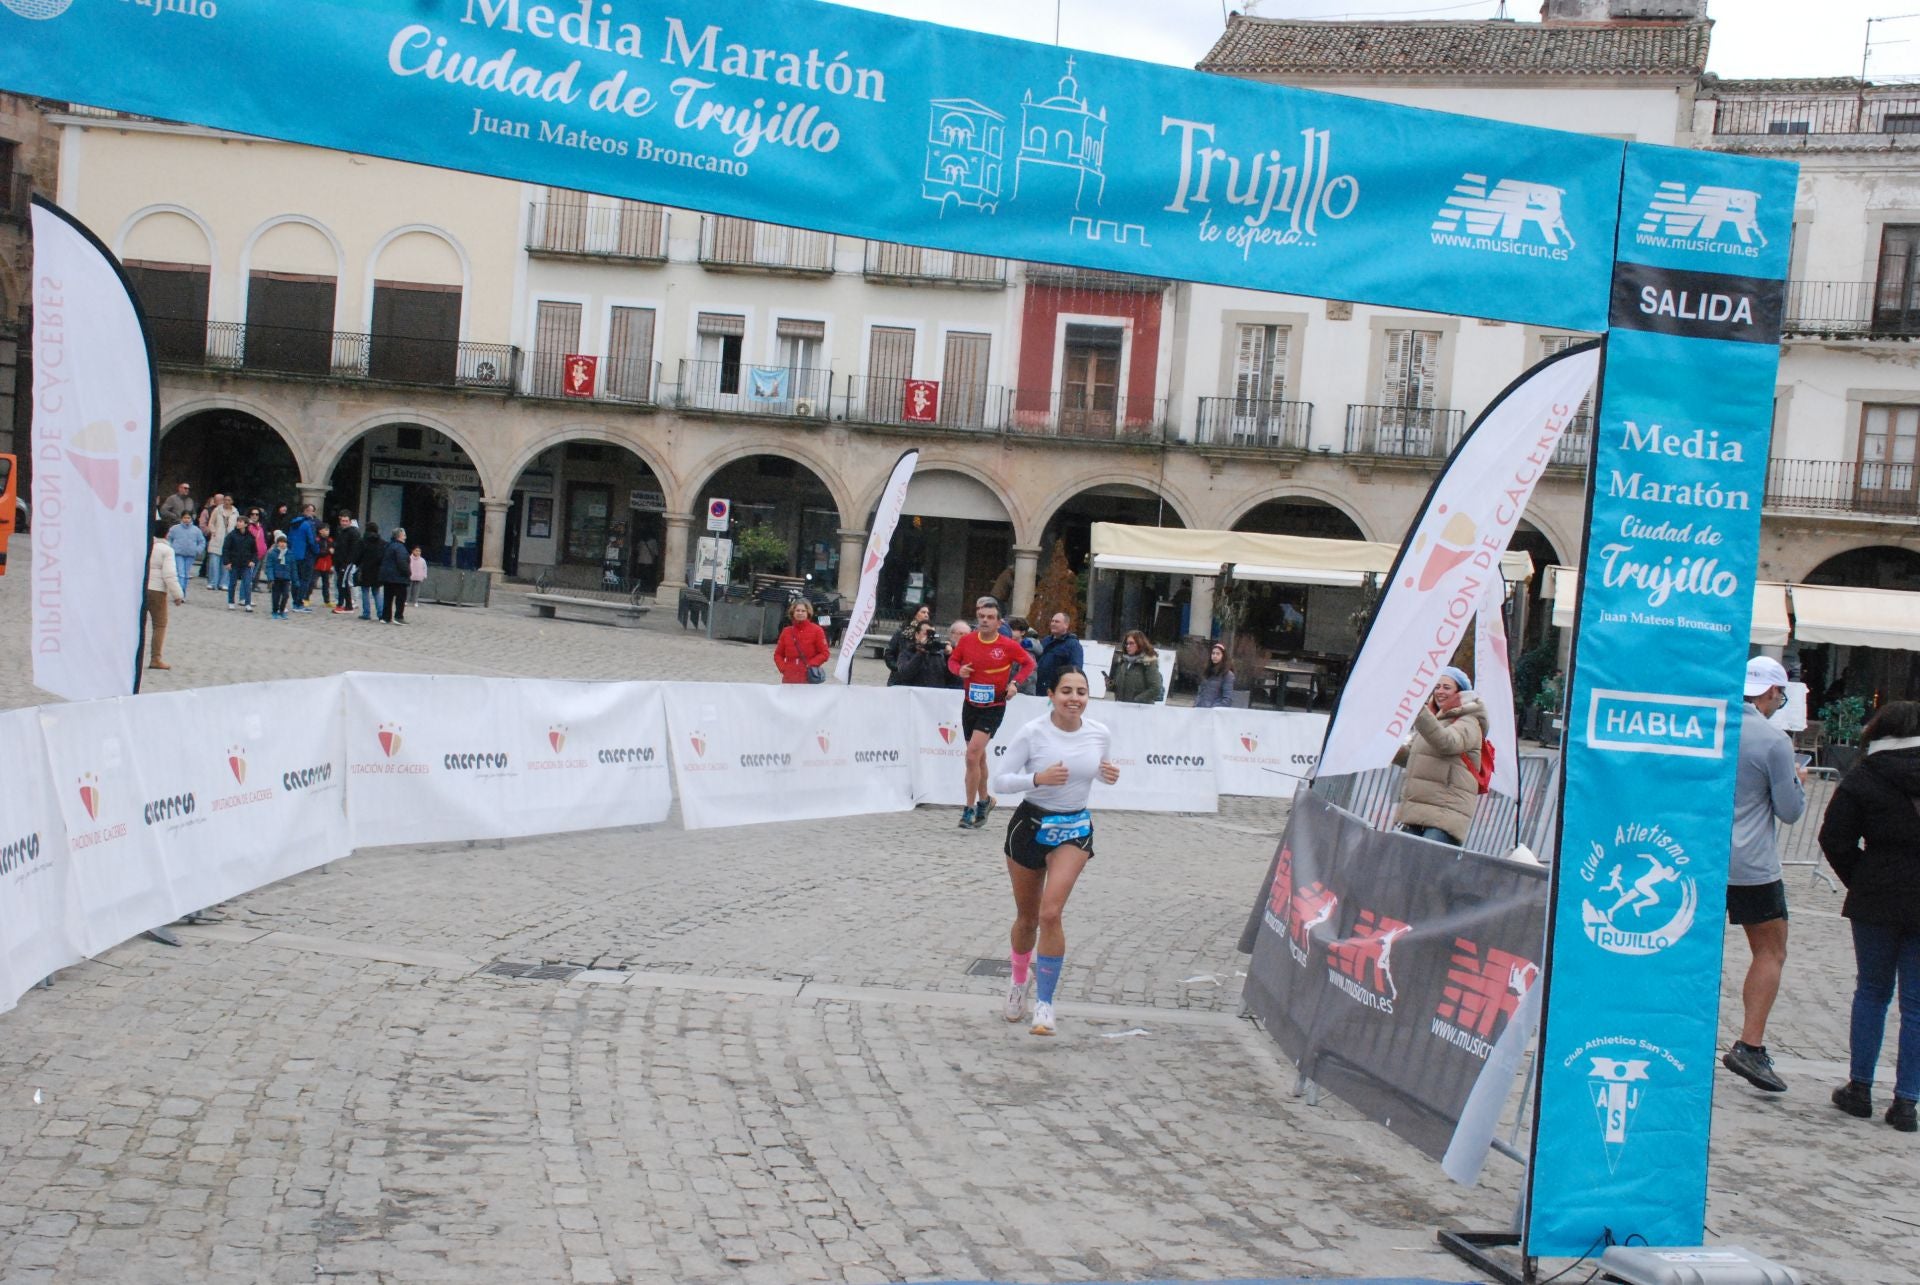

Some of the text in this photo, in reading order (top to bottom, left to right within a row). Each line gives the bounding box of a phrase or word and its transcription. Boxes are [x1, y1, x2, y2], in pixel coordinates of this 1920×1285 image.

[460, 0, 886, 103] Media Maratón
[388, 24, 841, 158] Ciudad de Trujillo
[469, 107, 749, 178] Juan Mateos Broncano
[1161, 115, 1359, 236] Trujillo
[1199, 211, 1318, 261] te espera...
[1430, 232, 1569, 262] www.musicrun.es
[1635, 233, 1759, 258] www.musicrun.es
[1639, 286, 1754, 325] SALIDA
[1619, 420, 1744, 463] Media
[1608, 470, 1750, 511] Maratón
[1620, 514, 1723, 546] Ciudad de
[1386, 402, 1570, 739] DIPUTACIÓN DE CÁCERES
[1600, 543, 1738, 607] Trujillo
[1600, 609, 1732, 633] Juan Mateos Broncano
[1606, 708, 1704, 739] HABLA
[1580, 822, 1690, 882] Club Atletismo
[1328, 968, 1394, 1014] www.musicrun.es
[1431, 1017, 1495, 1060] www.musicr
[1563, 1034, 1686, 1072] Club Athletico San José
[1596, 1086, 1638, 1109] A J
[1611, 1109, 1621, 1131] S
